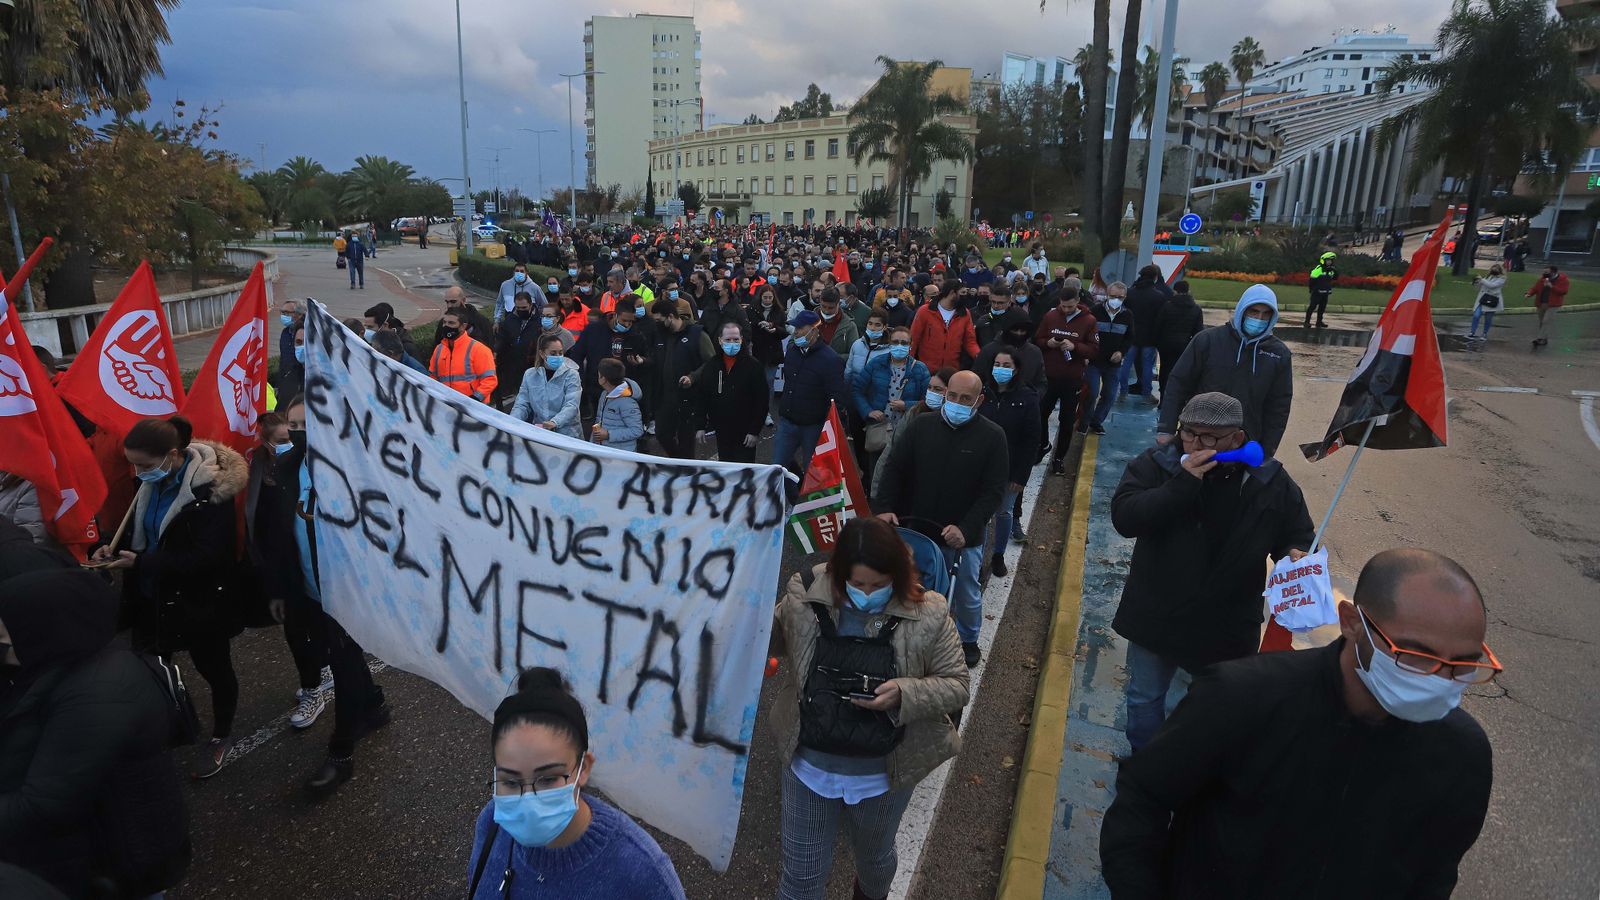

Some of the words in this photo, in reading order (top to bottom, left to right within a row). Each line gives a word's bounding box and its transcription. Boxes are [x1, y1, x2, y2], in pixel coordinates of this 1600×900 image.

[365, 347, 435, 437] UN
[305, 375, 372, 450] EN
[381, 431, 442, 501] EL
[458, 474, 736, 600] CONVENIO
[306, 446, 430, 578] DEL
[436, 534, 747, 755] METAL
[1273, 594, 1316, 614] METAL
[1281, 583, 1305, 599] DEL
